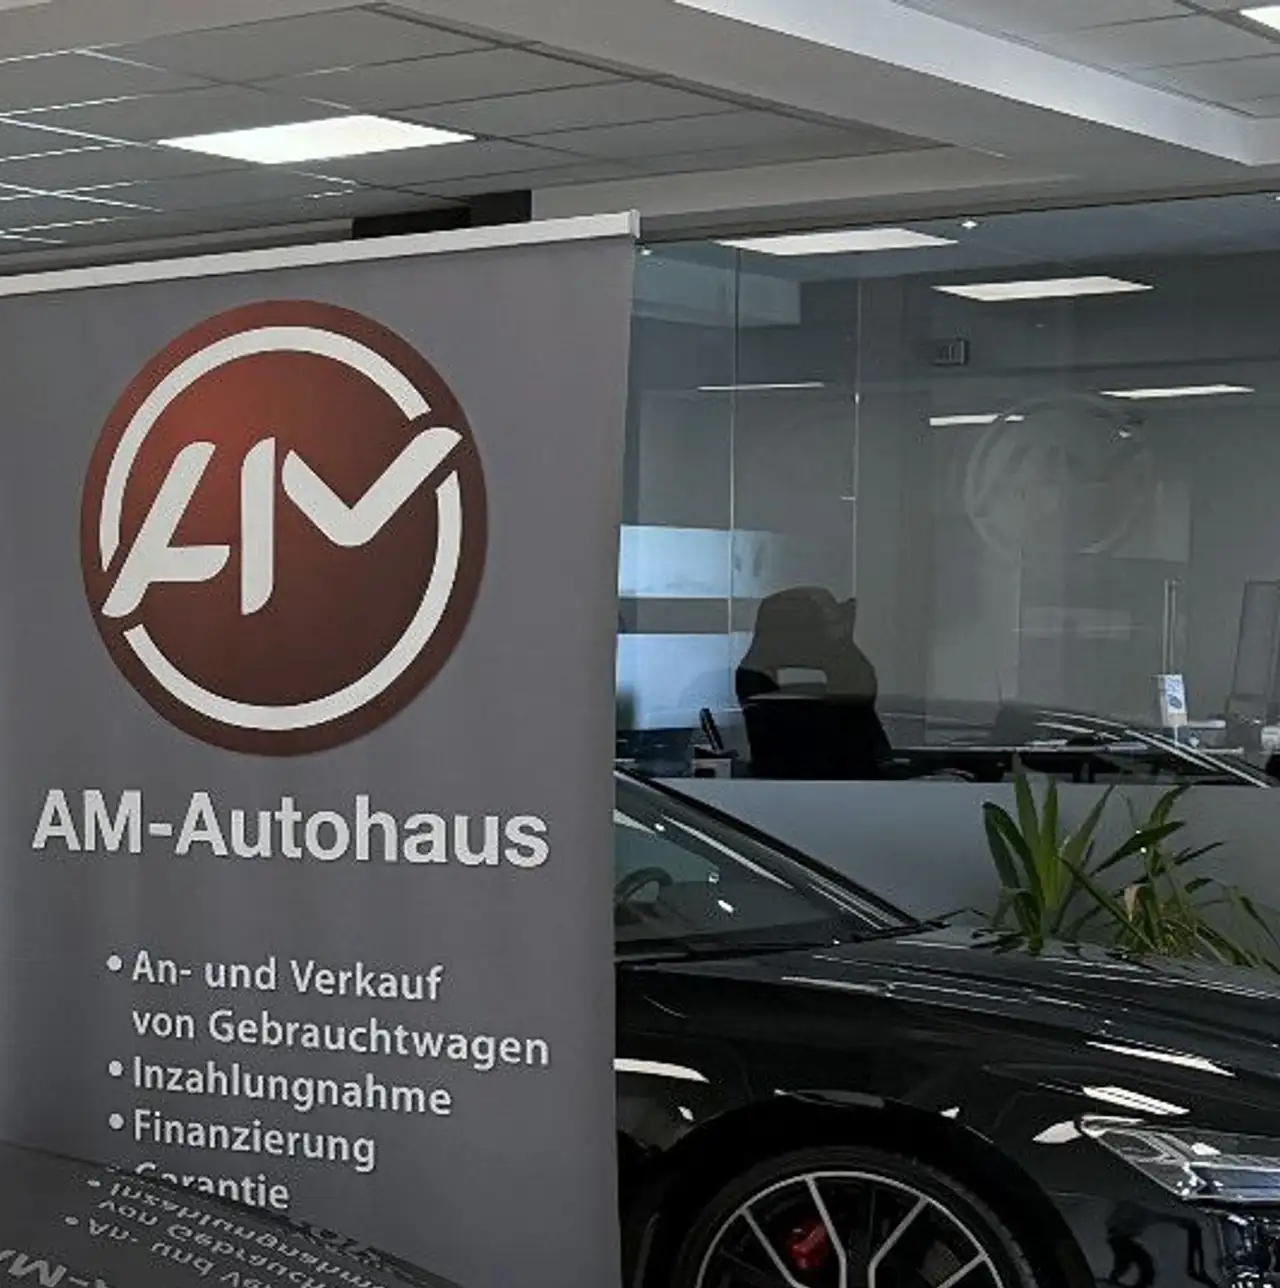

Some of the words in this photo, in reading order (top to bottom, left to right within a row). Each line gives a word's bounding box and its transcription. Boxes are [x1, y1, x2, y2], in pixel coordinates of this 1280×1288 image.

[101, 426, 462, 618] AM
[31, 788, 551, 869] AM-Autohaus
[132, 949, 192, 984] An-
[205, 956, 277, 990] und
[290, 958, 444, 1001] Verkauf
[132, 1010, 195, 1040] von
[209, 1008, 549, 1071] Gebrauchtwagen
[133, 1055, 452, 1116] Inzahlungnahme
[134, 1108, 375, 1172] Finanzierung
